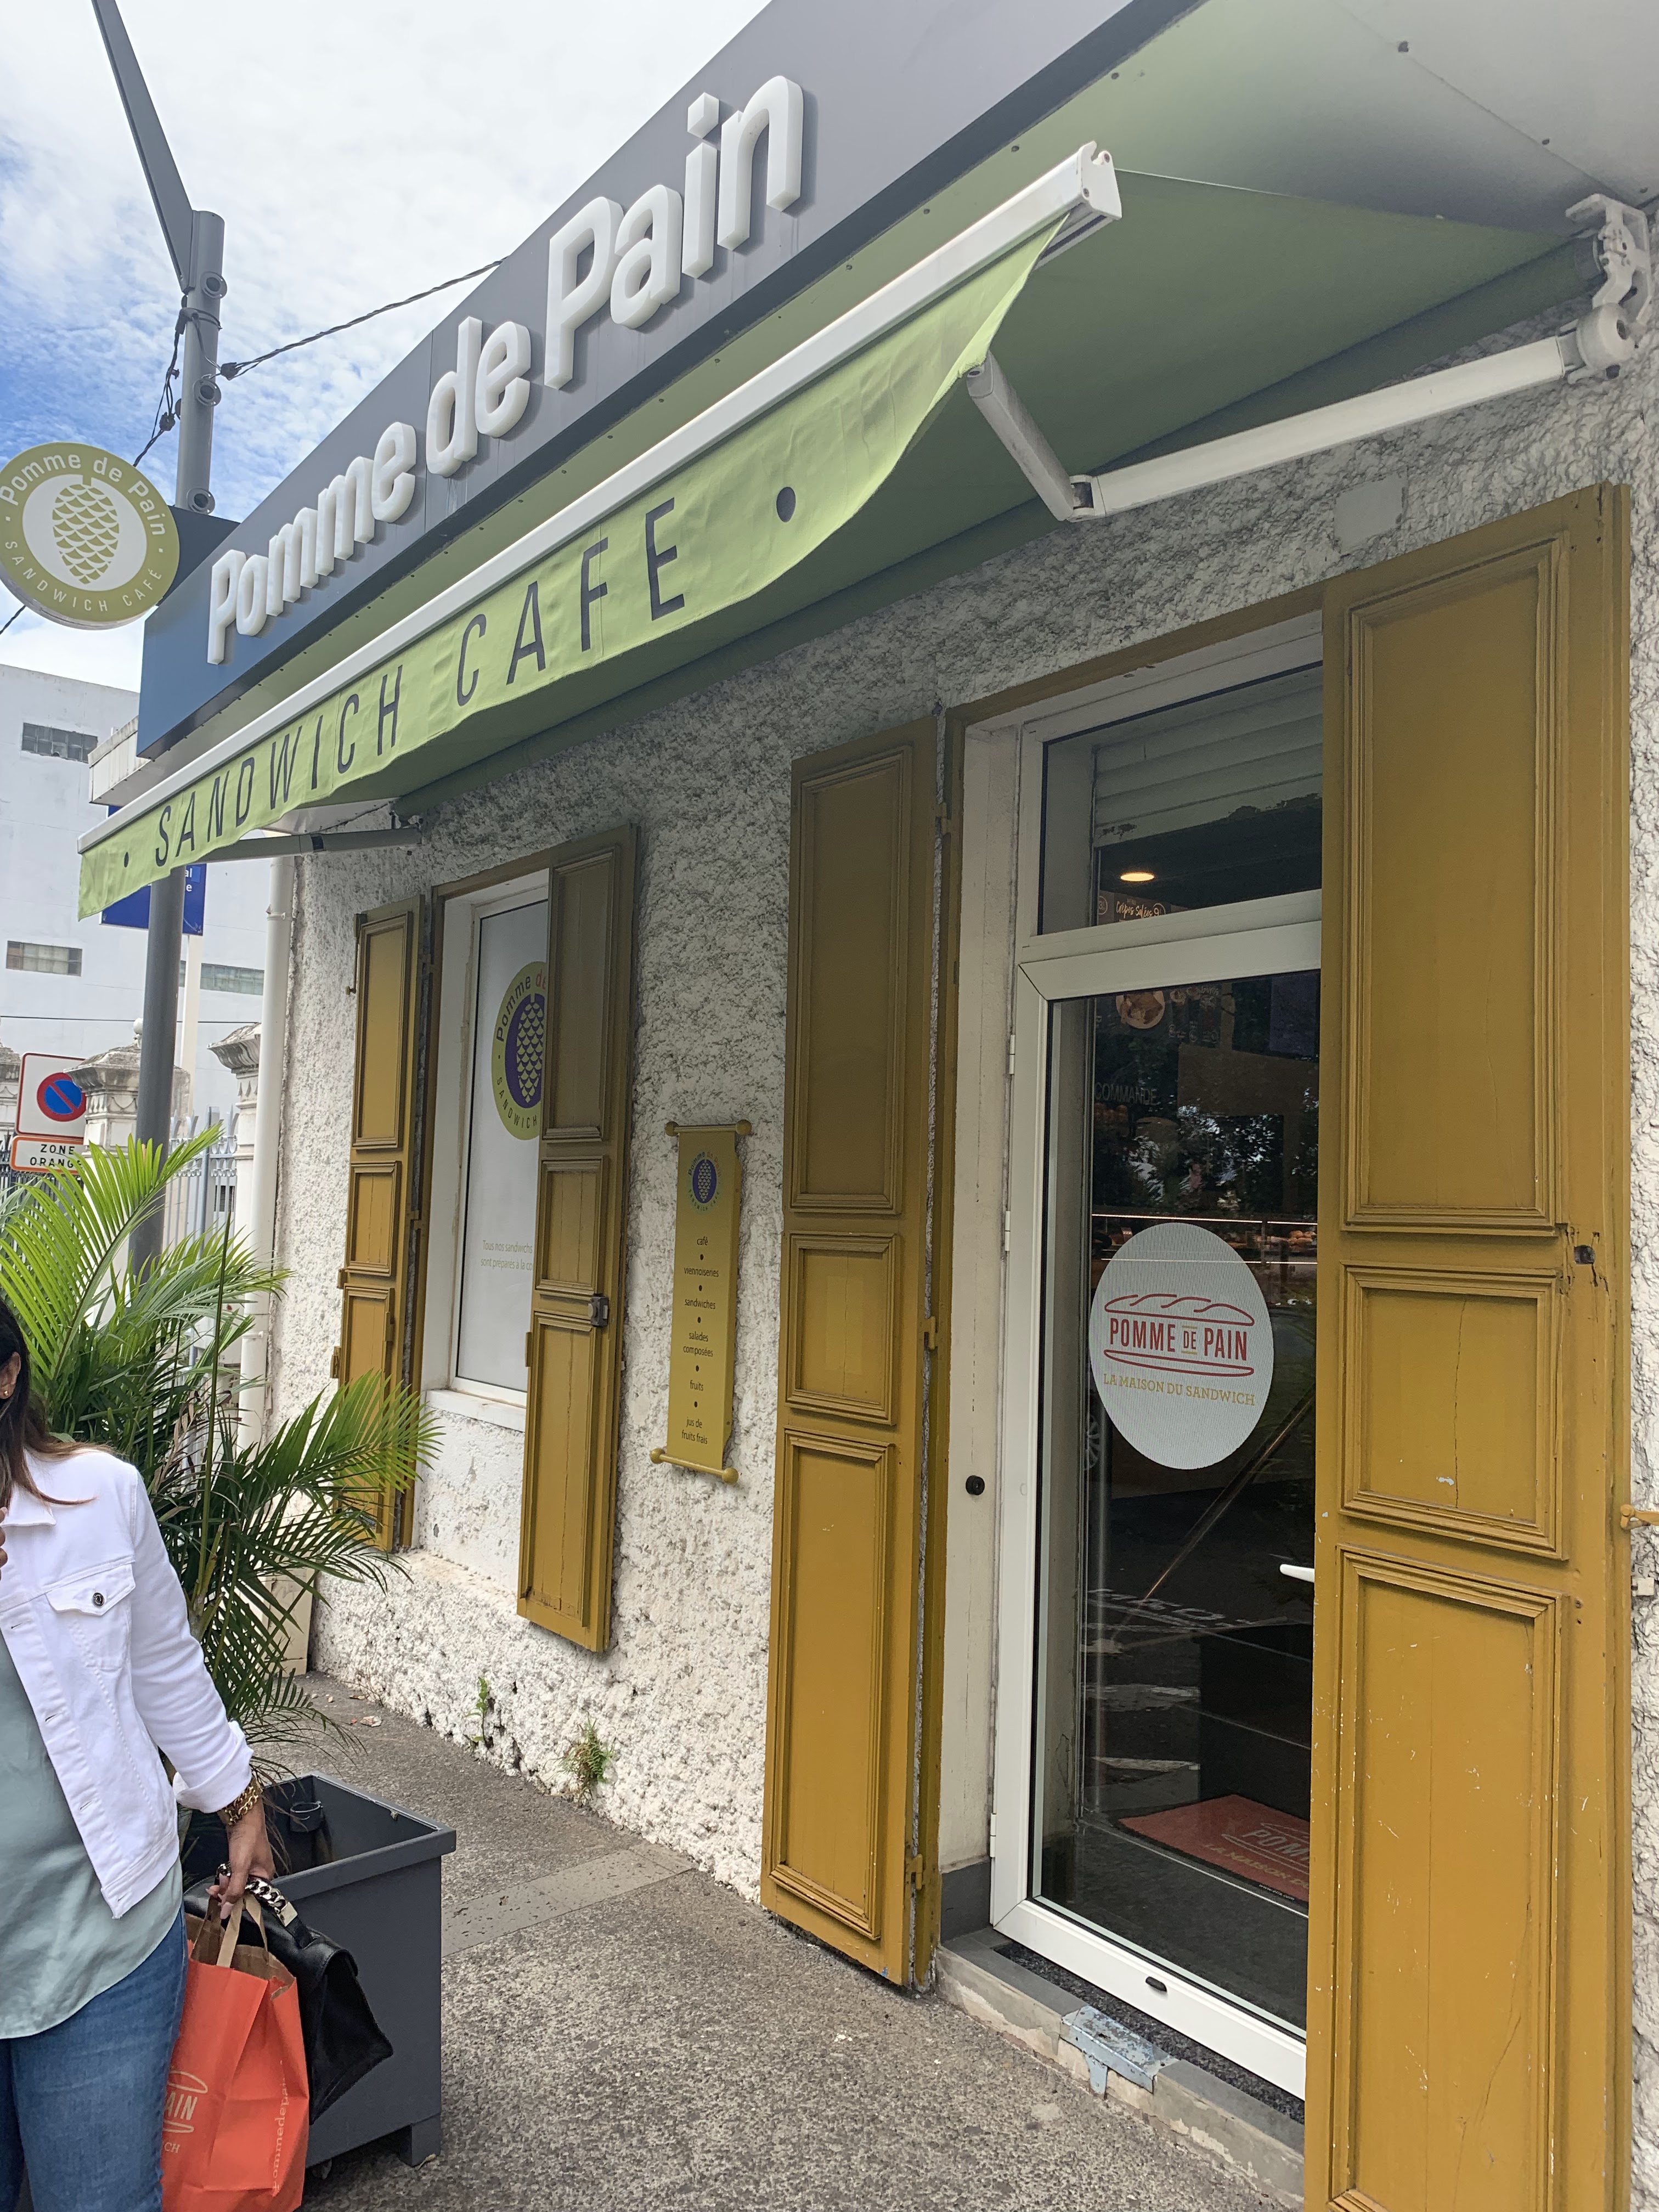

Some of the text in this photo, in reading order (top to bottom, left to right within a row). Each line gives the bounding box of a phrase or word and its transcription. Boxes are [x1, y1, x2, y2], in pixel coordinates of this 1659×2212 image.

[207, 75, 804, 665] Pomme de Pain
[0, 454, 166, 535] Pomme de Pain
[5, 541, 162, 612] SANDWICH CAFÉ
[156, 497, 685, 867] SANDWICH CAFE
[496, 975, 531, 1041] Pomme
[496, 1077, 537, 1129] SANDWICH
[41, 1144, 75, 1155] ZONE
[483, 1240, 533, 1254] Tous nos sandwichs
[697, 1237, 708, 1245] café
[481, 1258, 492, 1267] sont
[493, 1259, 515, 1271] préparés
[521, 1259, 525, 1270] la
[684, 1267, 719, 1277] viennoiseries
[685, 1299, 715, 1310] sandwiches
[689, 1331, 708, 1342] salades
[1110, 1318, 1247, 1361] POMME DE PAIN
[683, 1346, 713, 1357] composées
[690, 1380, 703, 1391] fruits
[1104, 1373, 1255, 1406] LA MAISON DU SANDWICH
[695, 1419, 702, 1429] de
[681, 1430, 708, 1444] fruits frais
[1242, 1829, 1310, 1861] POM
[165, 2091, 198, 2120] AIN
